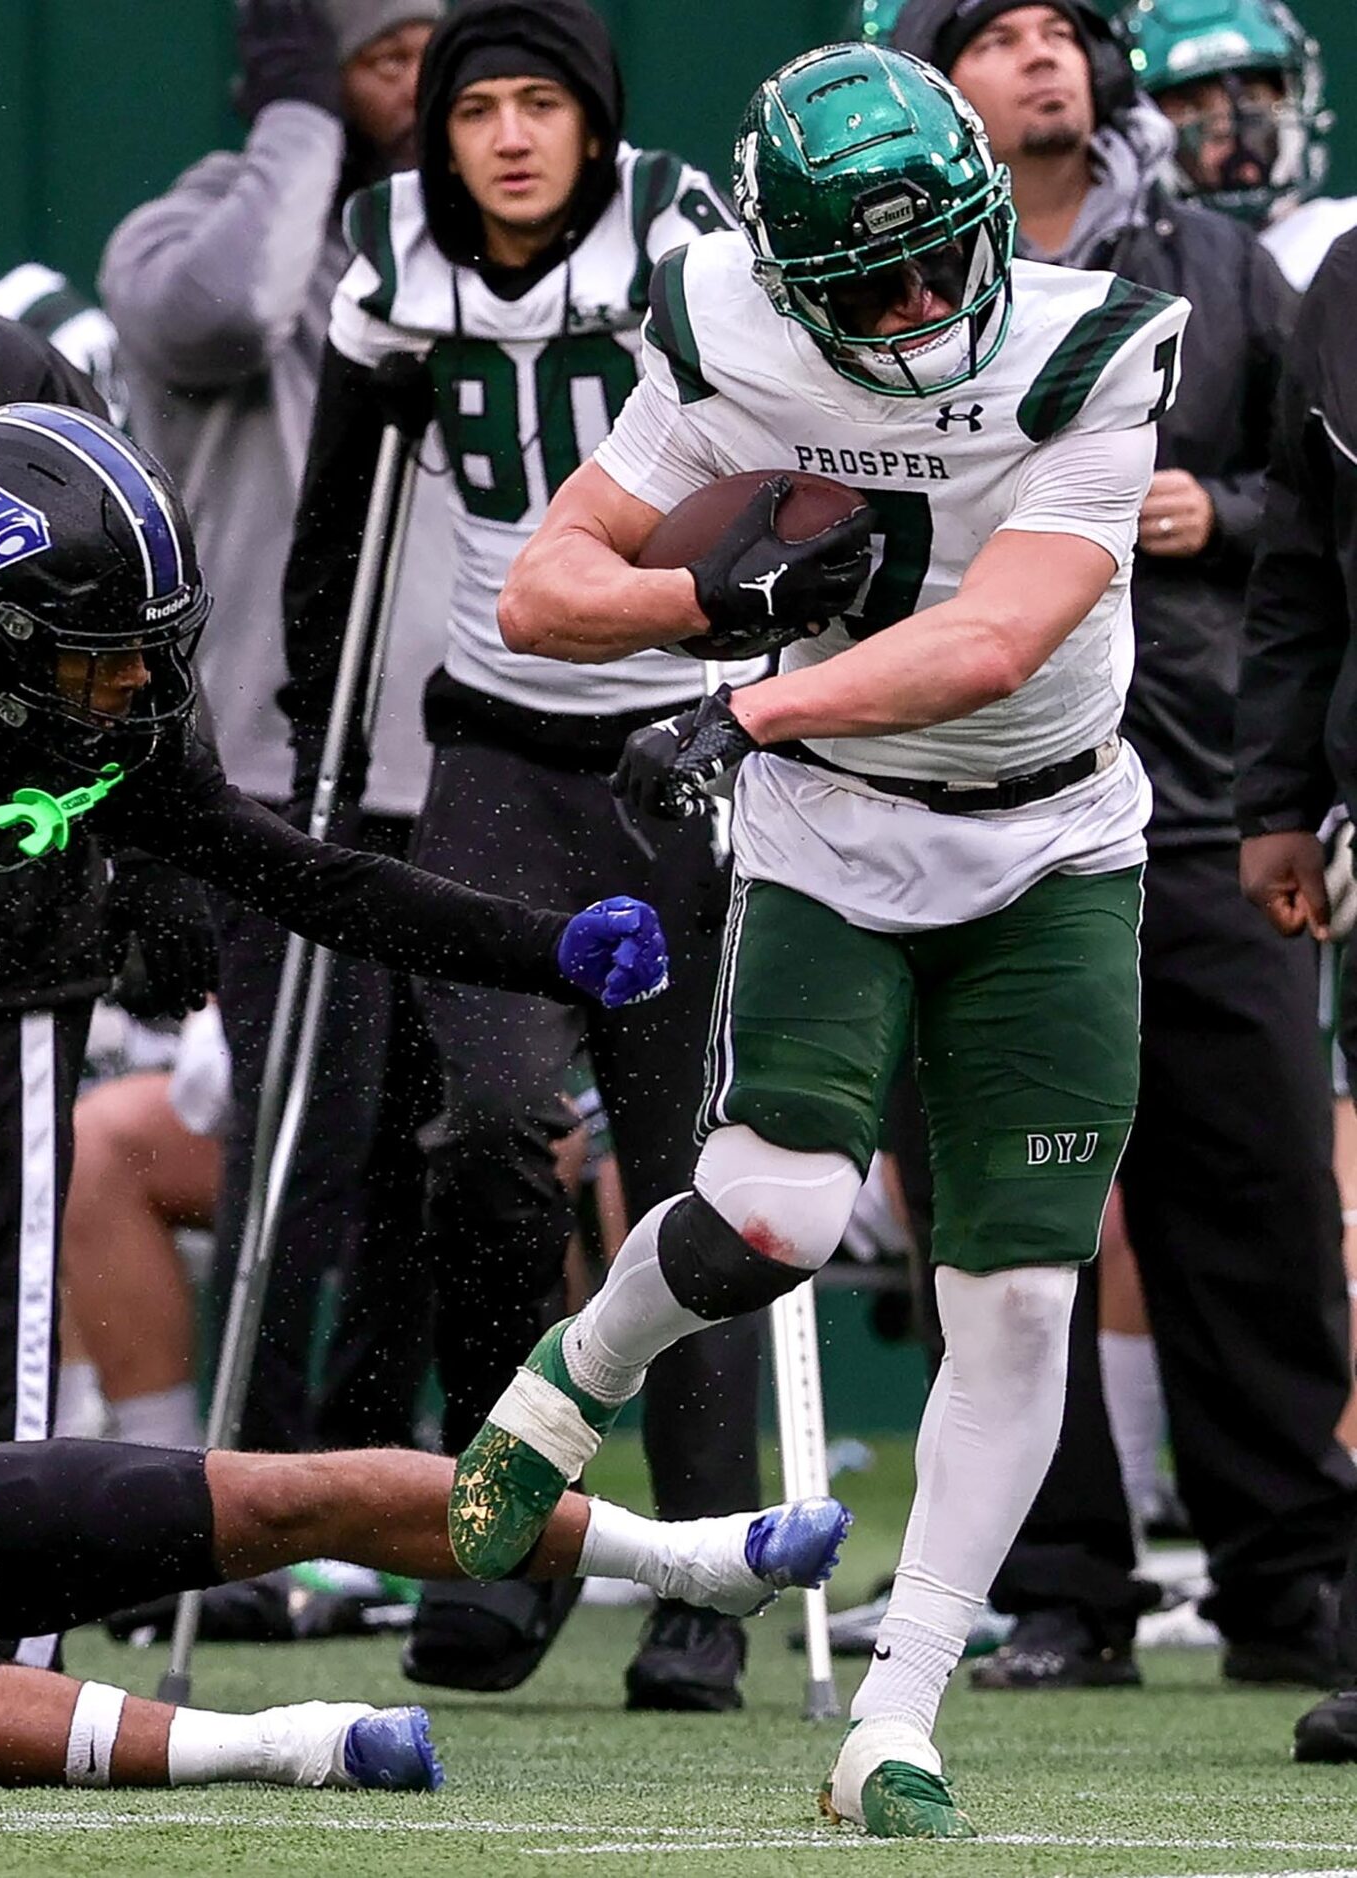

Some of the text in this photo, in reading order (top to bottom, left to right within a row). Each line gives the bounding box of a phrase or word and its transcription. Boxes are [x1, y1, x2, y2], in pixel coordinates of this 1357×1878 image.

[419, 331, 639, 523] 80
[794, 445, 951, 480] PROSPER
[1027, 1132, 1099, 1165] DYJ
